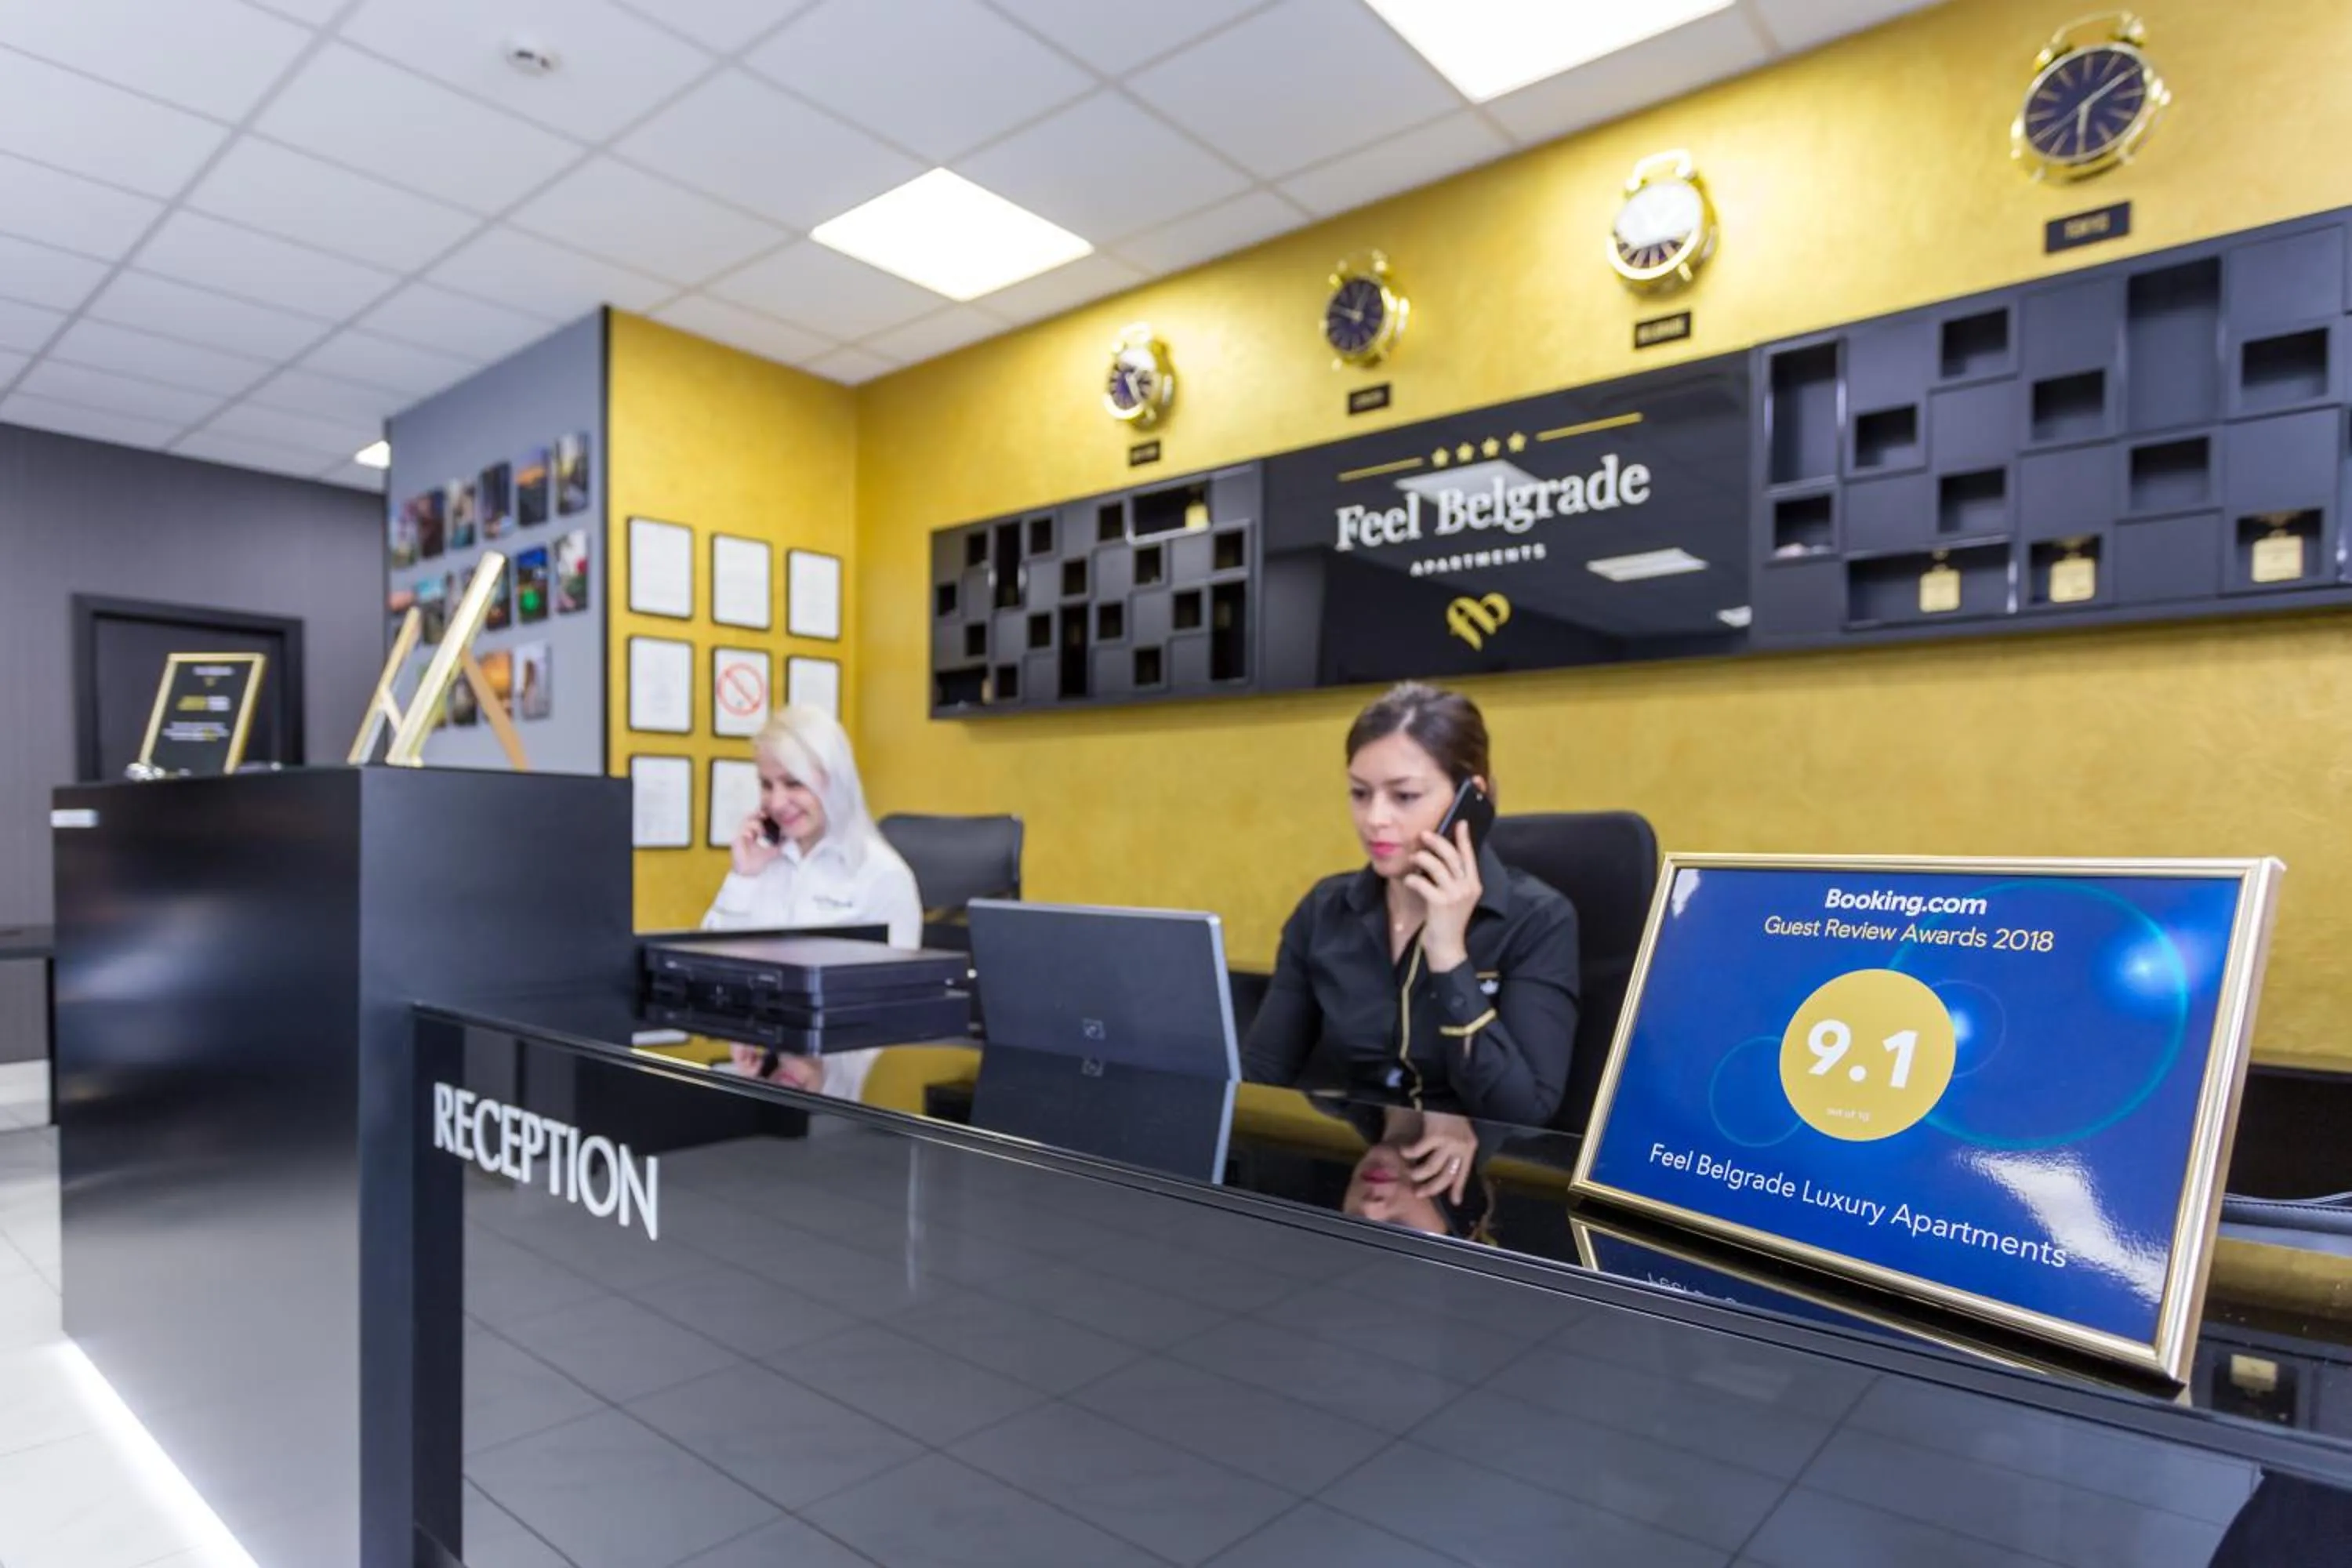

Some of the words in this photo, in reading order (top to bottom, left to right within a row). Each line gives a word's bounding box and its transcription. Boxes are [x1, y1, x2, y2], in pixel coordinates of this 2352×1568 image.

[1335, 492, 1421, 551] Feel
[1436, 454, 1651, 535] Belgrade
[1411, 543, 1546, 576] APARTMENTS
[1765, 916, 1820, 937] Guest
[1824, 918, 1896, 942] Review
[1900, 924, 1987, 948] Awards
[1992, 928, 2054, 952] 2018
[1825, 888, 1987, 916] Booking.com
[1808, 1019, 1918, 1088] 9.1
[434, 1082, 658, 1241] RECEPTION
[1650, 1143, 1692, 1172] Feel
[1696, 1154, 1795, 1199] Belgrade
[1802, 1180, 1885, 1226] Luxury
[1890, 1203, 2067, 1269] Apartments
